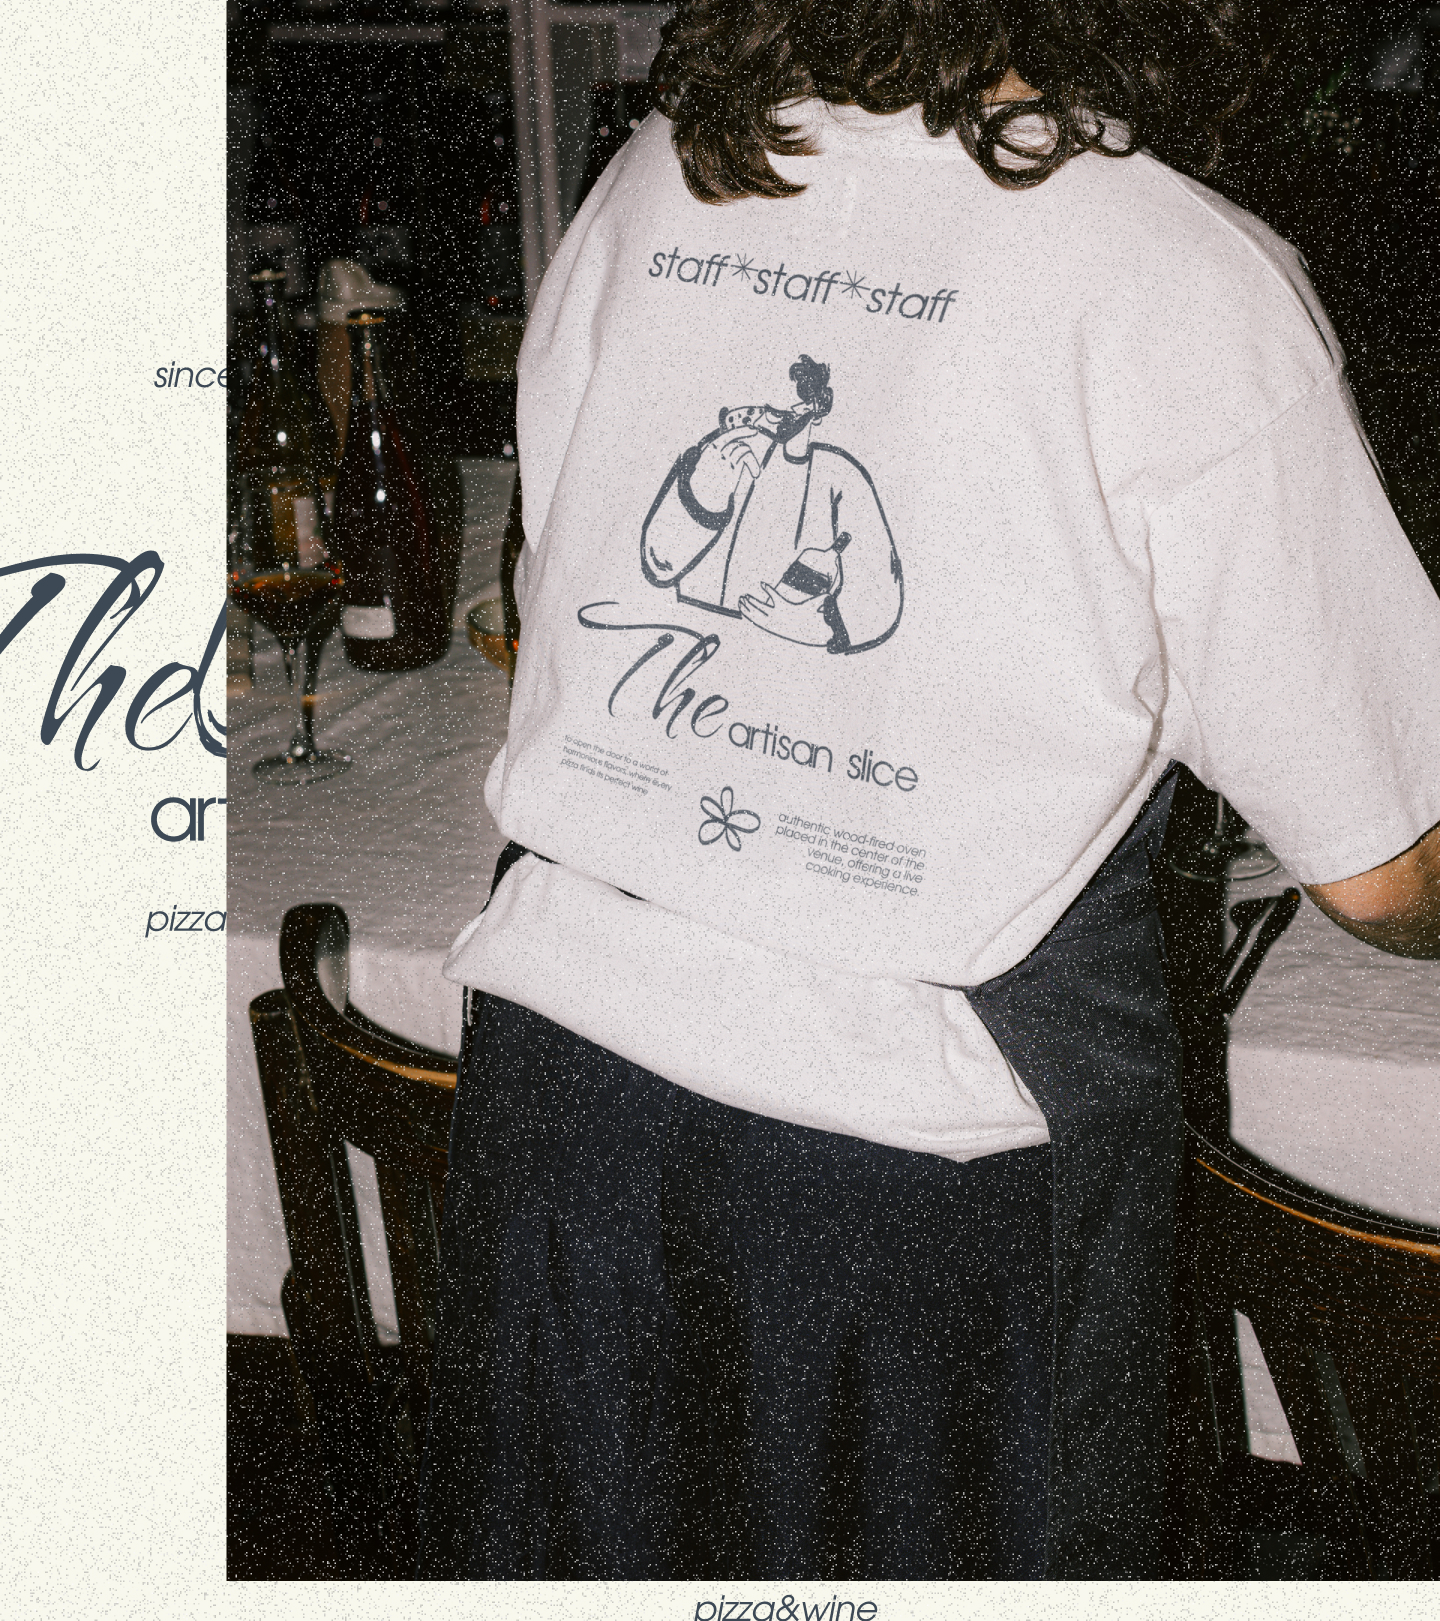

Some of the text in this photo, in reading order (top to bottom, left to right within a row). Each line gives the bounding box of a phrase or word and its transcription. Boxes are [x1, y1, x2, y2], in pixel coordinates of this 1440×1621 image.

[577, 600, 729, 739] The
[560, 758, 579, 770] pizza
[565, 734, 573, 743] to
[573, 738, 592, 750] open
[593, 743, 605, 754] the
[606, 749, 623, 760] door
[728, 722, 919, 792] artisan slice
[775, 825, 925, 871] placed in the center of the
[778, 812, 927, 857] authentic wood-fired oven
[805, 861, 920, 897] cooking experience.
[807, 847, 923, 884] venue, offering a live
[694, 1594, 878, 1621] pizza&wine
